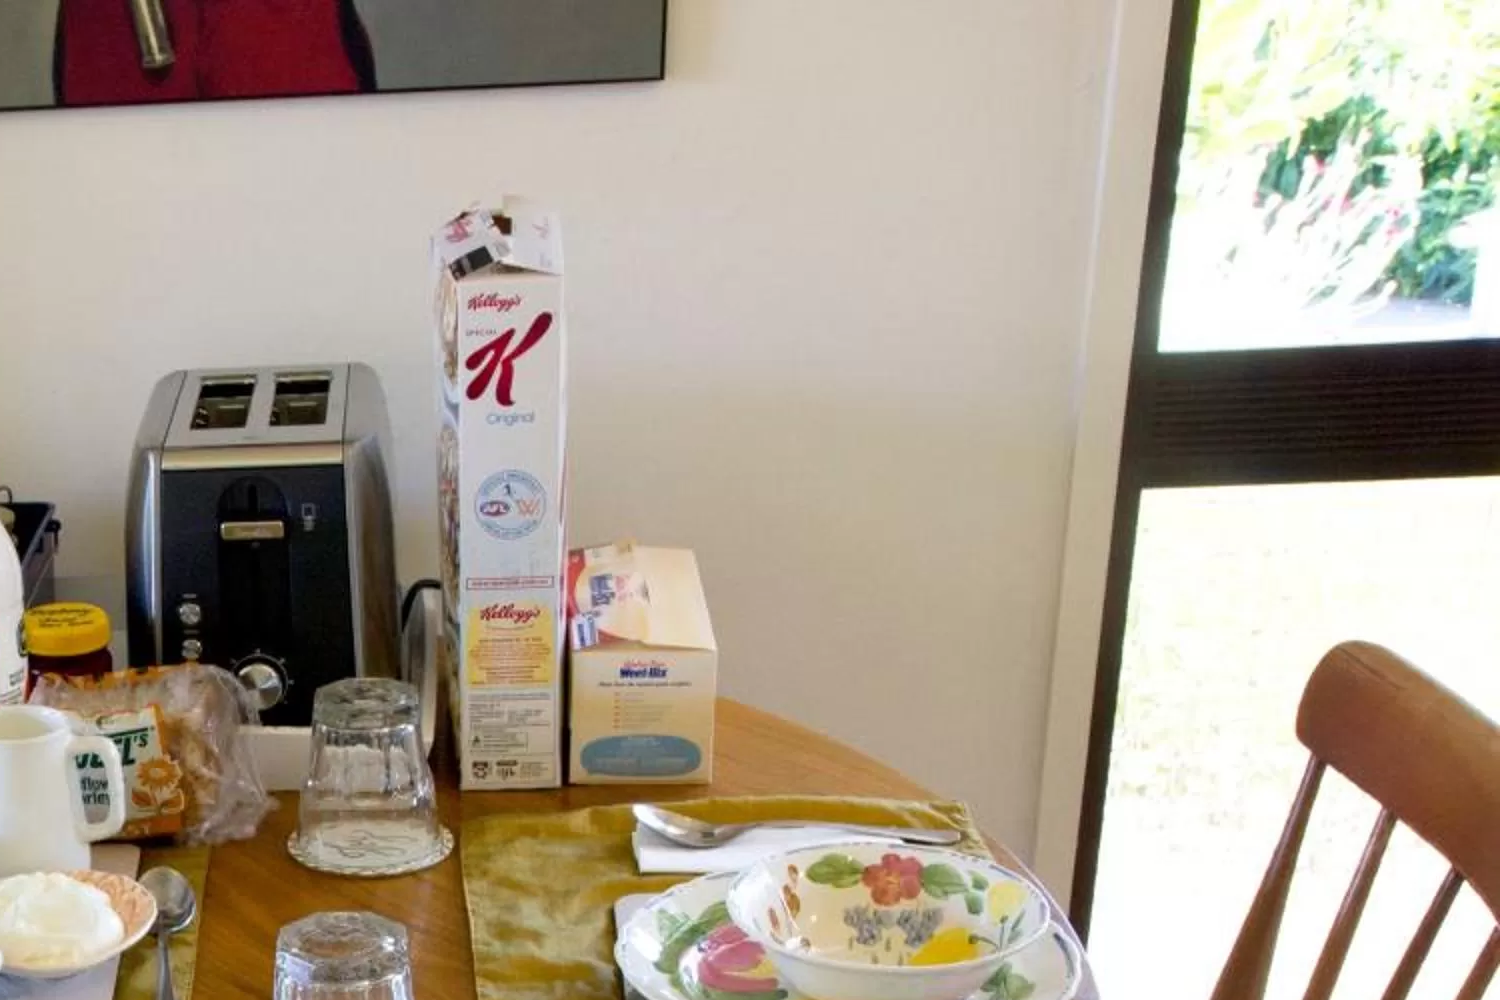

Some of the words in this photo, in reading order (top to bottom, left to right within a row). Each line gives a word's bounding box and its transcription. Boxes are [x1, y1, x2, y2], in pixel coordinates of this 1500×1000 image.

[467, 292, 522, 312] Kellogg's
[465, 311, 553, 407] K
[485, 409, 535, 426] Original
[479, 603, 541, 624] Kellogg's
